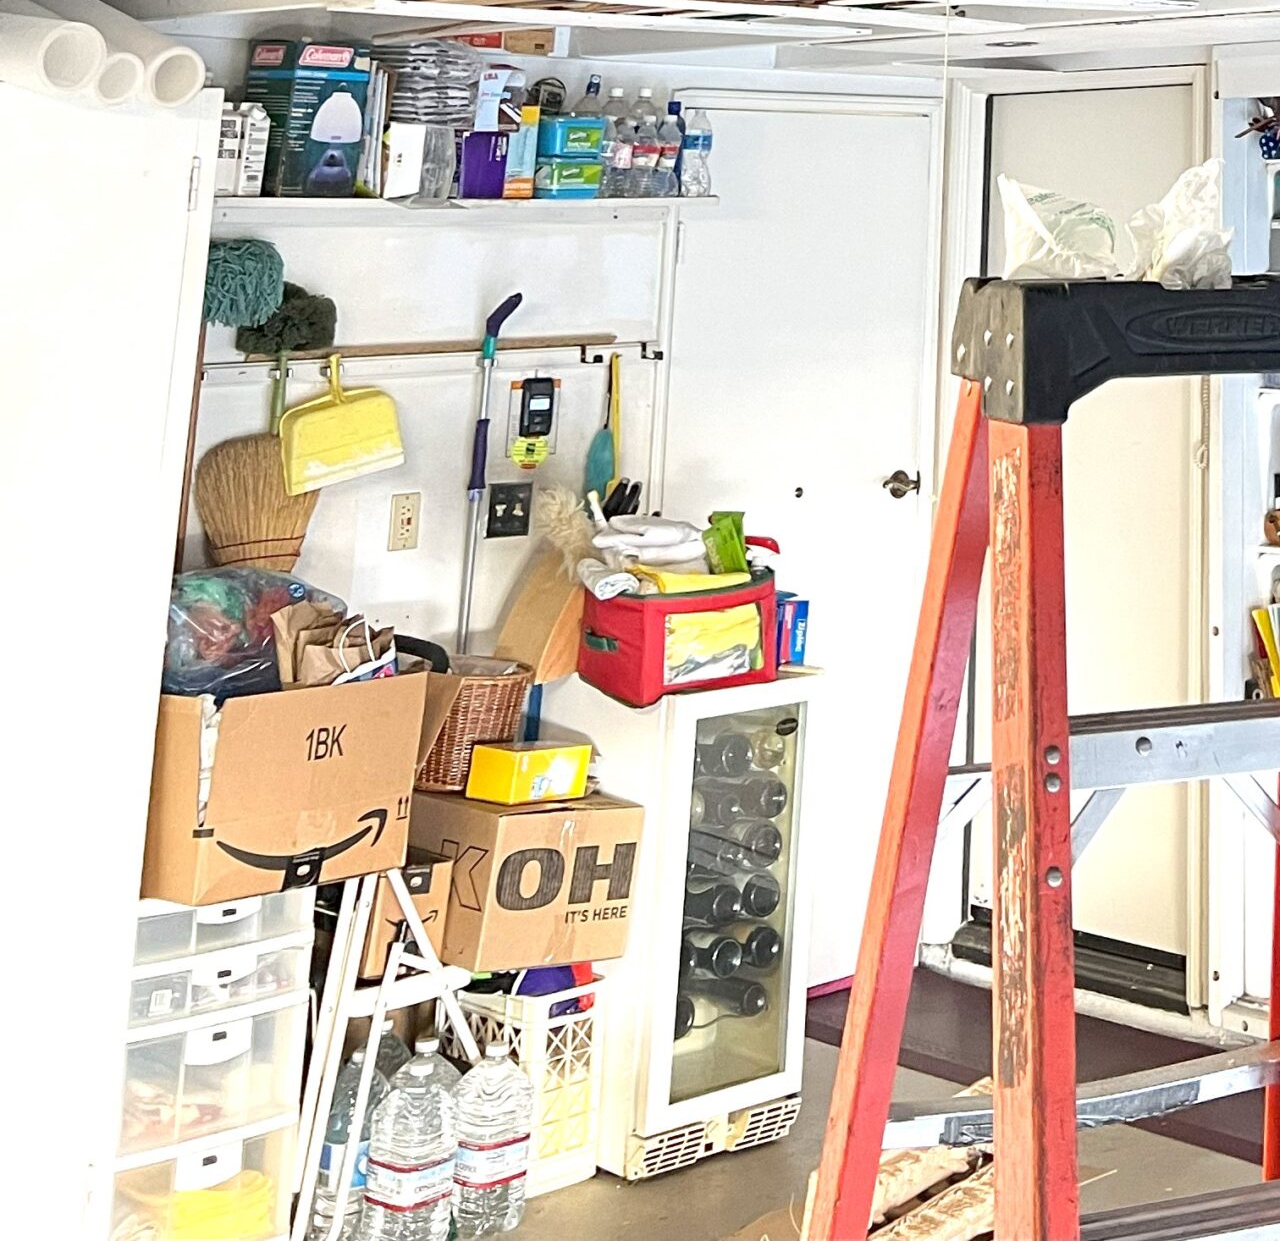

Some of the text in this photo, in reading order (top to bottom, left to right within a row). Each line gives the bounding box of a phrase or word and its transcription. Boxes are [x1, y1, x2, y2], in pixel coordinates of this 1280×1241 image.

[305, 48, 345, 63] Coleman
[1166, 315, 1280, 338] WERNER
[305, 724, 348, 762] 1BK
[496, 841, 638, 912] OH
[565, 905, 629, 925] IT'S HERE
